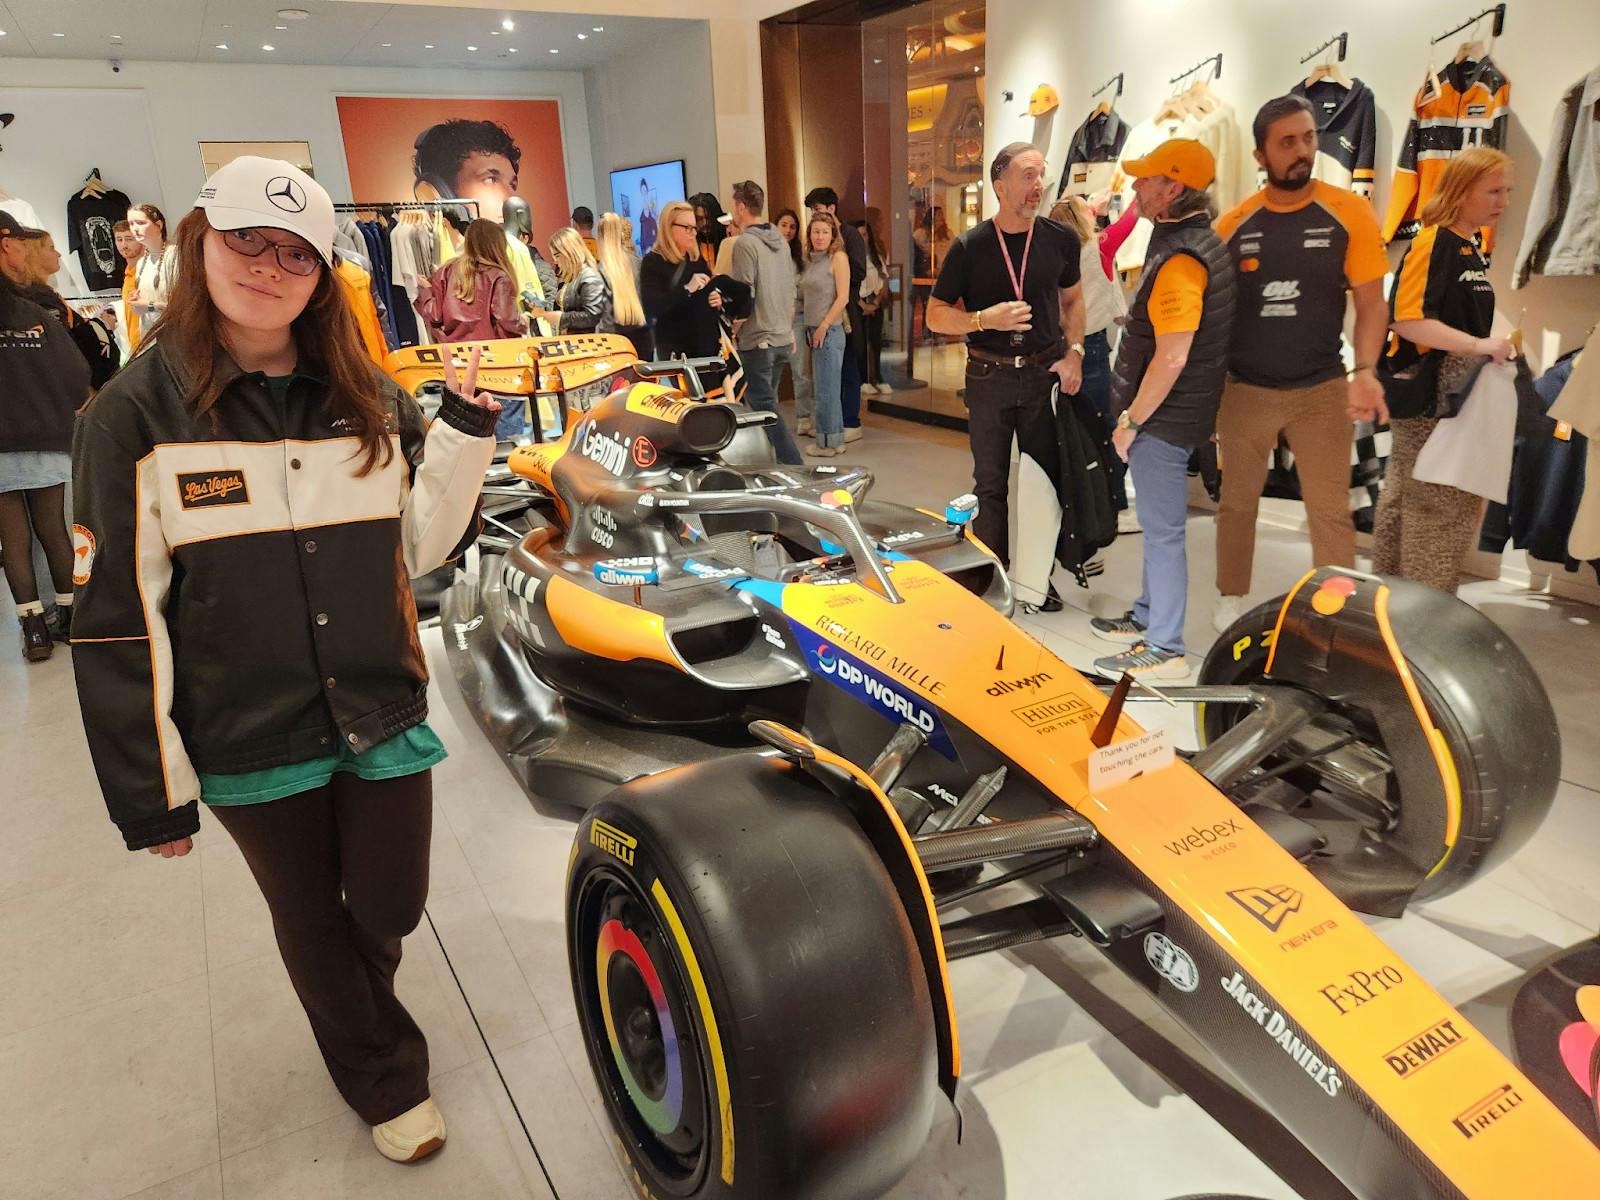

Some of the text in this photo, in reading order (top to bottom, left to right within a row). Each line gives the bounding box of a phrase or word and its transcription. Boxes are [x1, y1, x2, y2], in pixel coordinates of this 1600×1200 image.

[582, 419, 630, 477] Gemini
[184, 475, 241, 500] Las Vegas
[815, 614, 887, 661] RICHARD
[887, 656, 947, 696] MILLE
[837, 658, 935, 733] DP WORLD
[985, 671, 1054, 697] allwyn
[1021, 699, 1083, 722] Hilton
[1036, 724, 1057, 736] FOR
[1057, 718, 1078, 728] THE
[1099, 757, 1134, 774] touching
[1134, 751, 1148, 761] the
[1100, 730, 1164, 759] Thank you for not
[590, 818, 638, 868] PIRELLI
[1163, 818, 1245, 857] webex
[1318, 965, 1404, 1016] FxPro
[1220, 971, 1343, 1097] JACK DANIEL'S
[1451, 1083, 1524, 1140] PIRELLI
